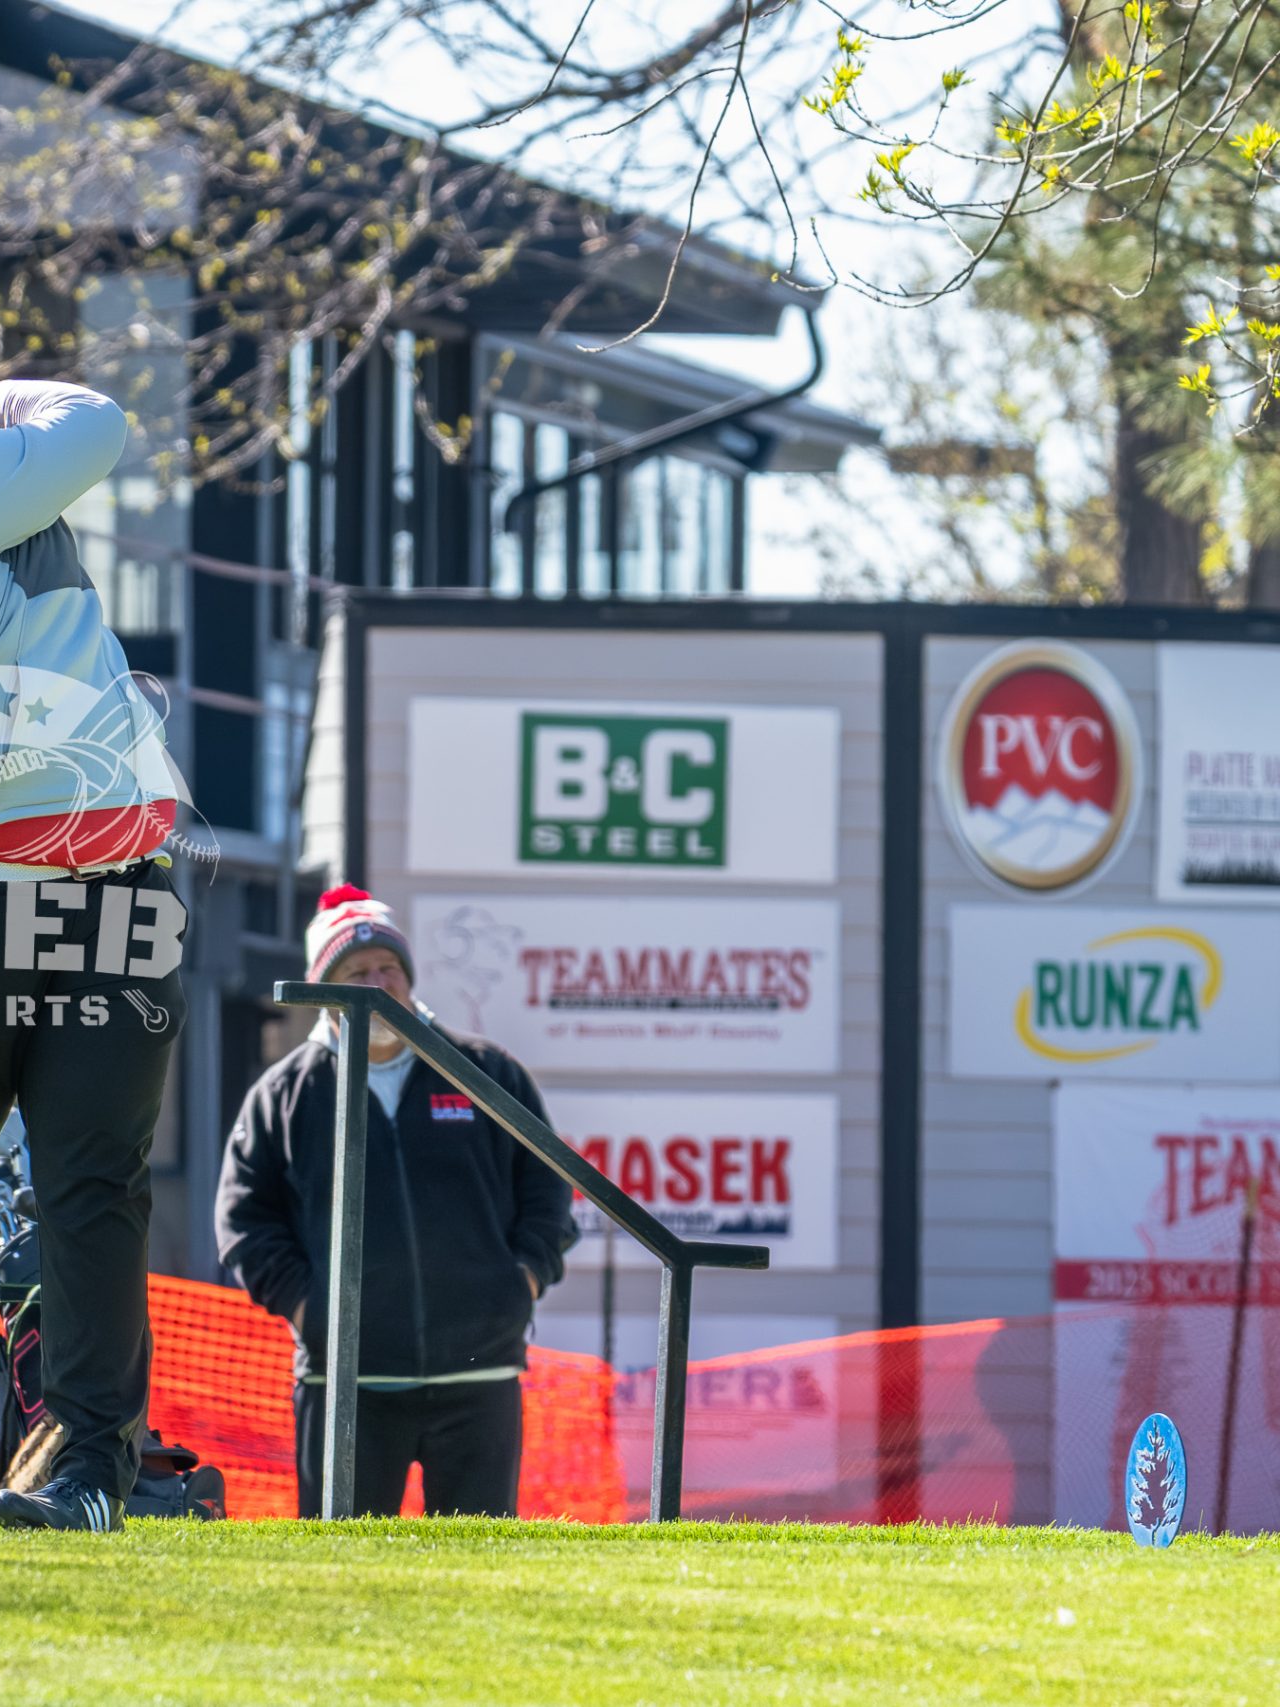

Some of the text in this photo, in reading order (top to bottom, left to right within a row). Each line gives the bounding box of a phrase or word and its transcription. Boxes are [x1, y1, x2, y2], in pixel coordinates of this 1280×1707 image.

[531, 724, 717, 825] B&C
[979, 713, 1104, 781] PVC
[530, 824, 716, 859] STEEL
[519, 945, 813, 1013] TEAMMATES
[1033, 957, 1202, 1034] RUNZA
